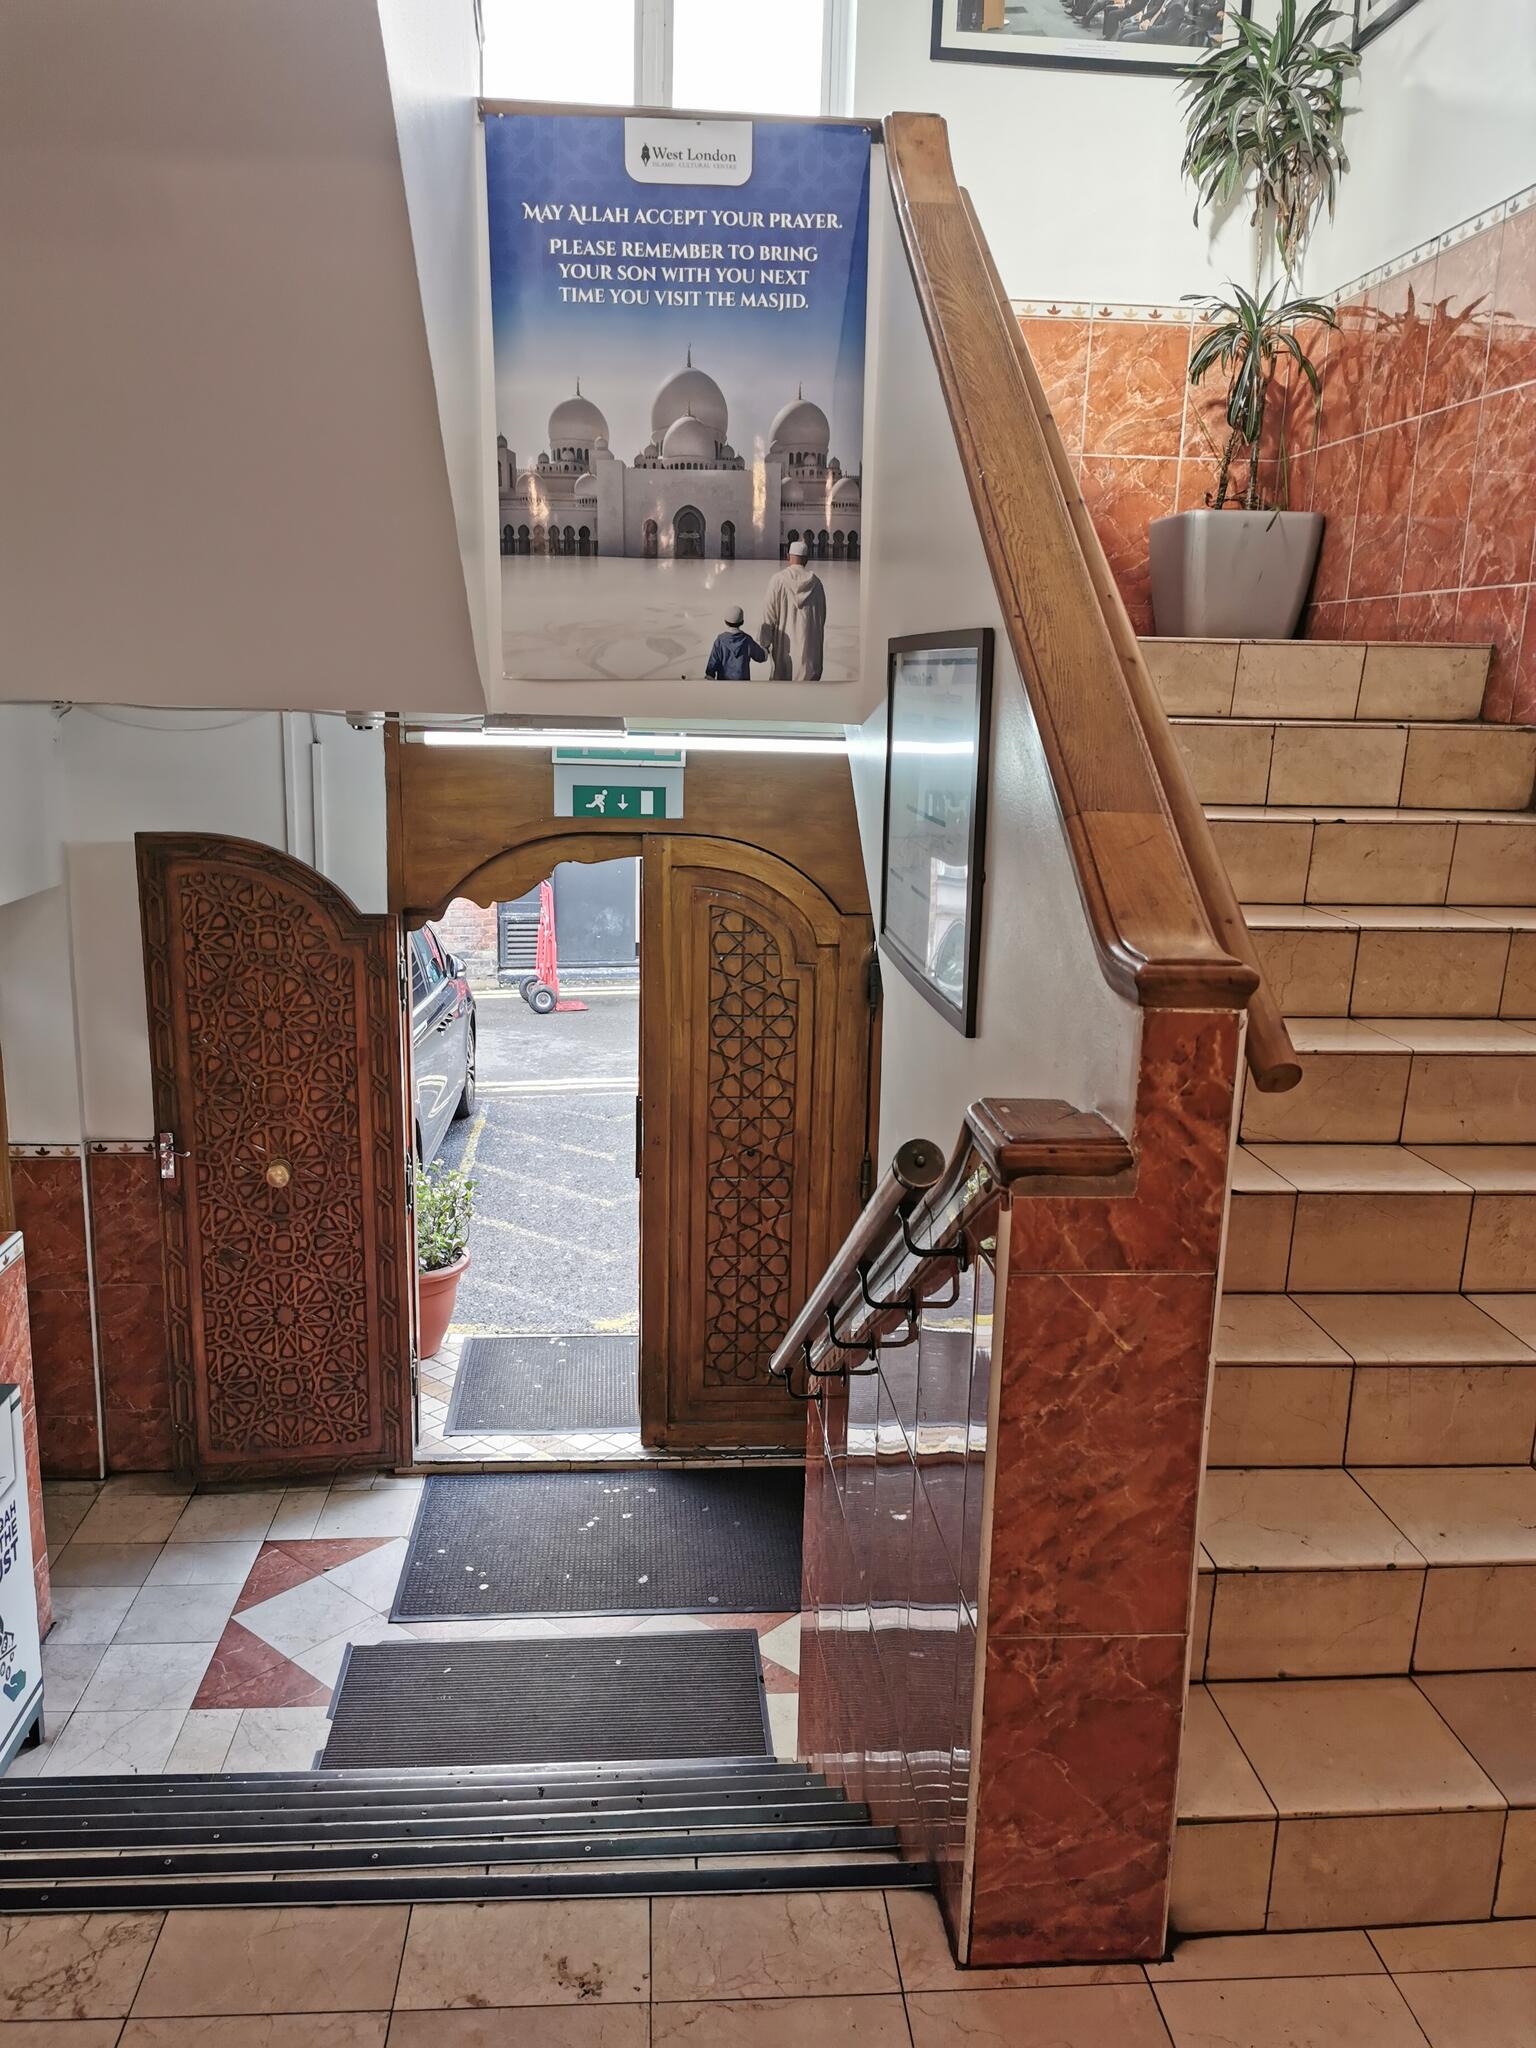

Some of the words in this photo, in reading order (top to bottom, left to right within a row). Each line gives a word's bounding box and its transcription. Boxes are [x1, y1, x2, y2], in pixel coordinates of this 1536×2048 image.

[652, 146, 683, 160] West
[687, 148, 736, 162] London
[521, 202, 564, 224] MAY
[568, 204, 629, 225] ALLAH
[634, 208, 707, 226] ACCEPT
[711, 210, 764, 228] YOUR
[769, 212, 843, 229] PRAYER.
[550, 238, 616, 257] PLEASE
[622, 241, 724, 259] REMEMBER
[728, 244, 755, 260] TO
[759, 245, 818, 262] BRING
[558, 262, 613, 280] YOUR
[617, 265, 656, 281] SON
[661, 266, 710, 283] WITH
[715, 267, 755, 284] YOU
[760, 269, 810, 285] NEXT
[558, 286, 605, 303] TIME
[609, 288, 650, 305] YOU
[655, 290, 702, 306] VISIT
[706, 291, 736, 307] THE
[740, 292, 809, 312] MASJID.
